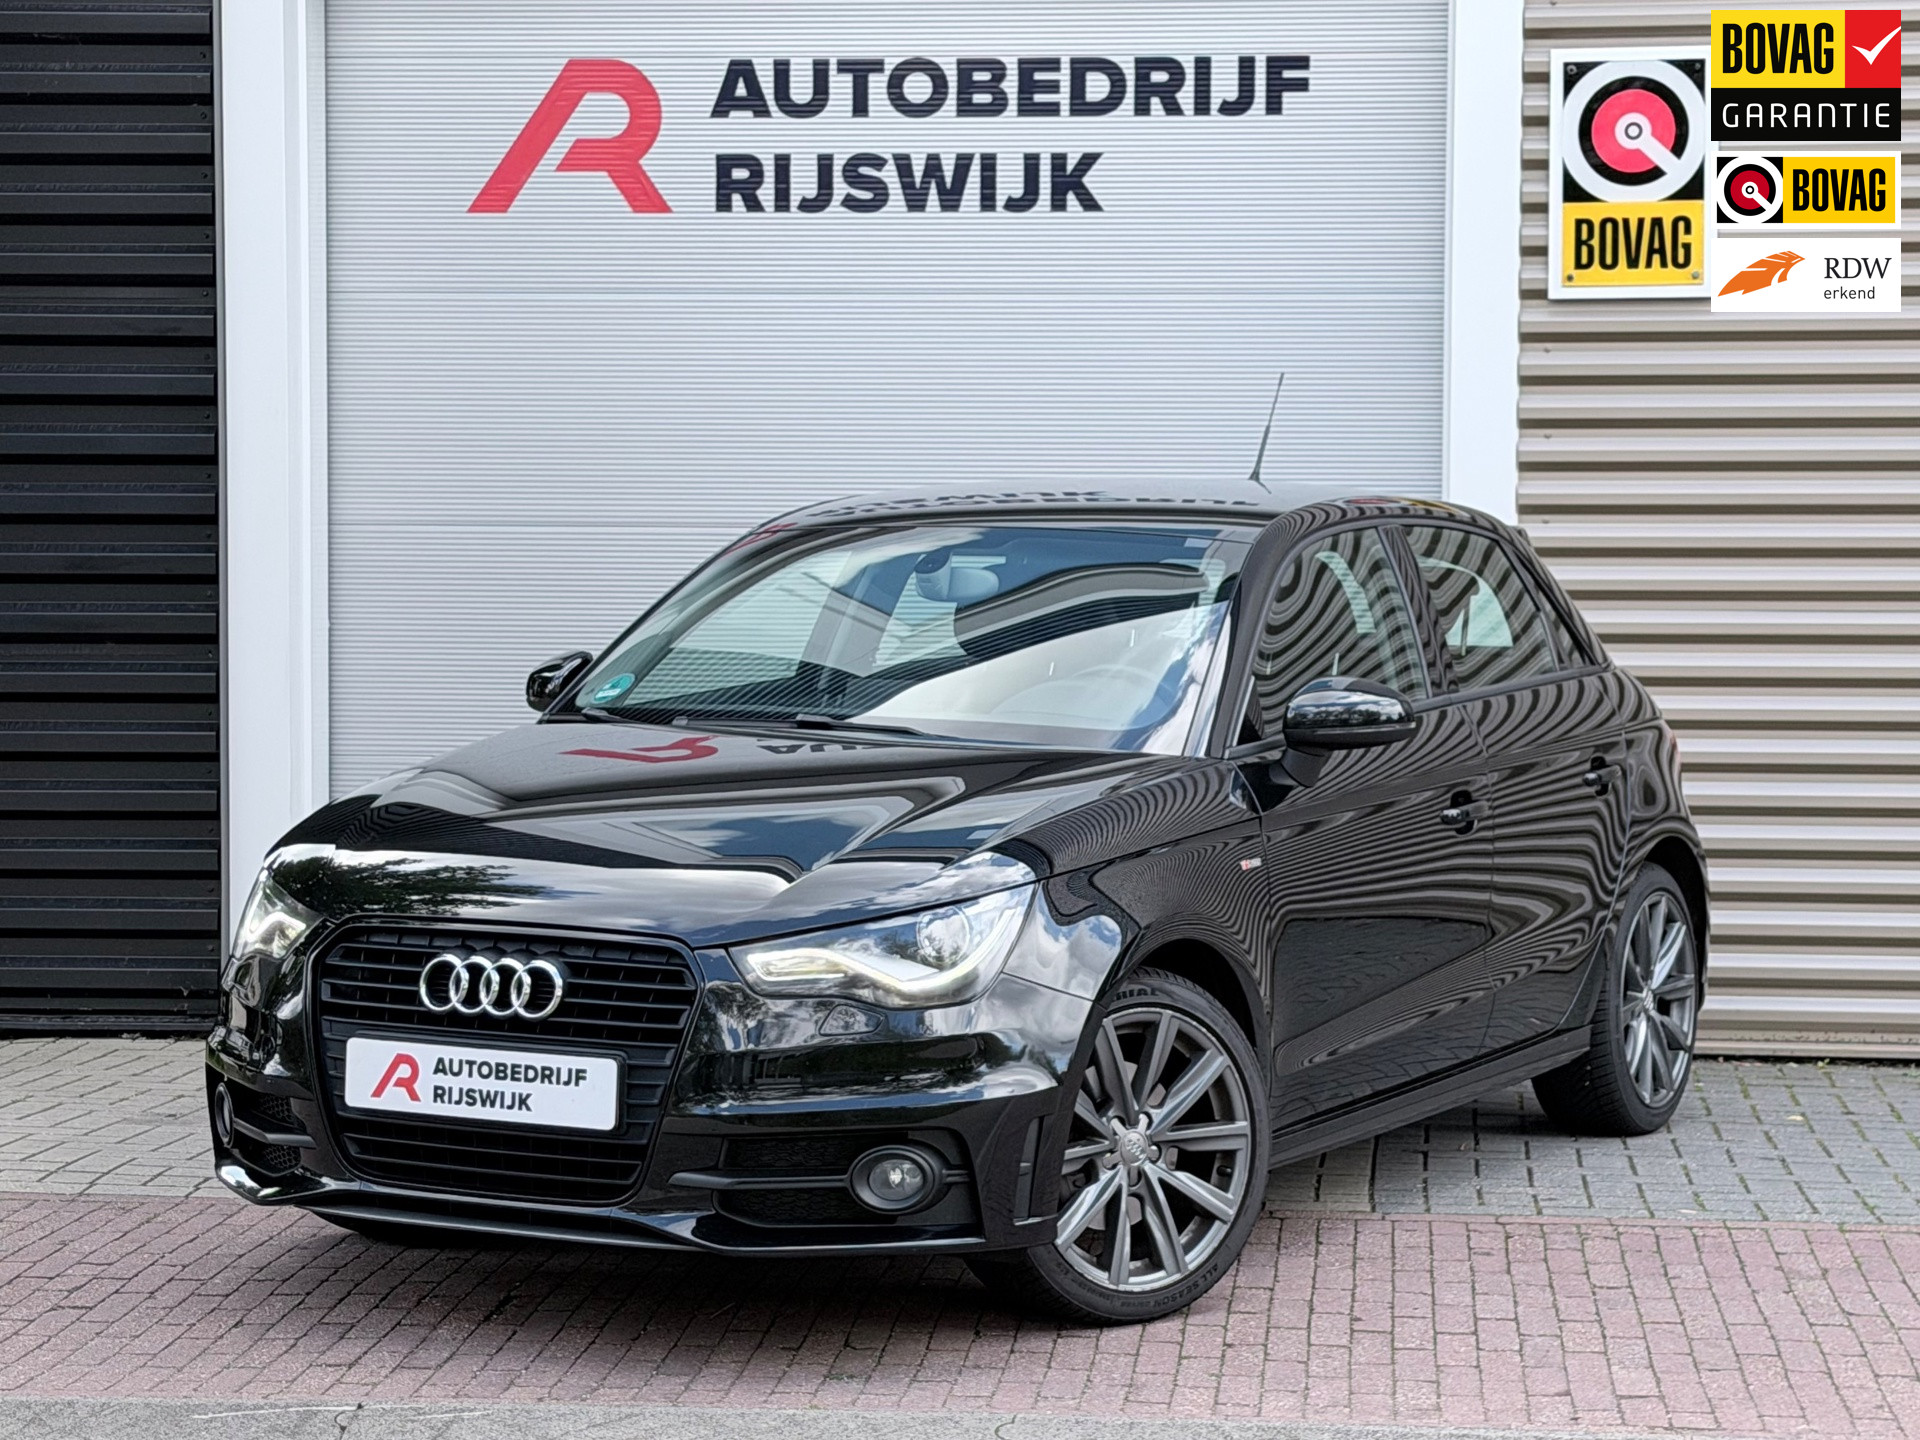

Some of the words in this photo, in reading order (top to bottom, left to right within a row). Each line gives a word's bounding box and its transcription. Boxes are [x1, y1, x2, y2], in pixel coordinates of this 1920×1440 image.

[710, 55, 1311, 119] AUTOBEDRIJF
[715, 152, 1104, 214] RIJSWIJK
[1573, 215, 1693, 271] BOVAG
[432, 1057, 588, 1087] AUTOBEDRIJF
[432, 1085, 532, 1112] RIJSWIJK
[1153, 1281, 1200, 1307] SEASON
